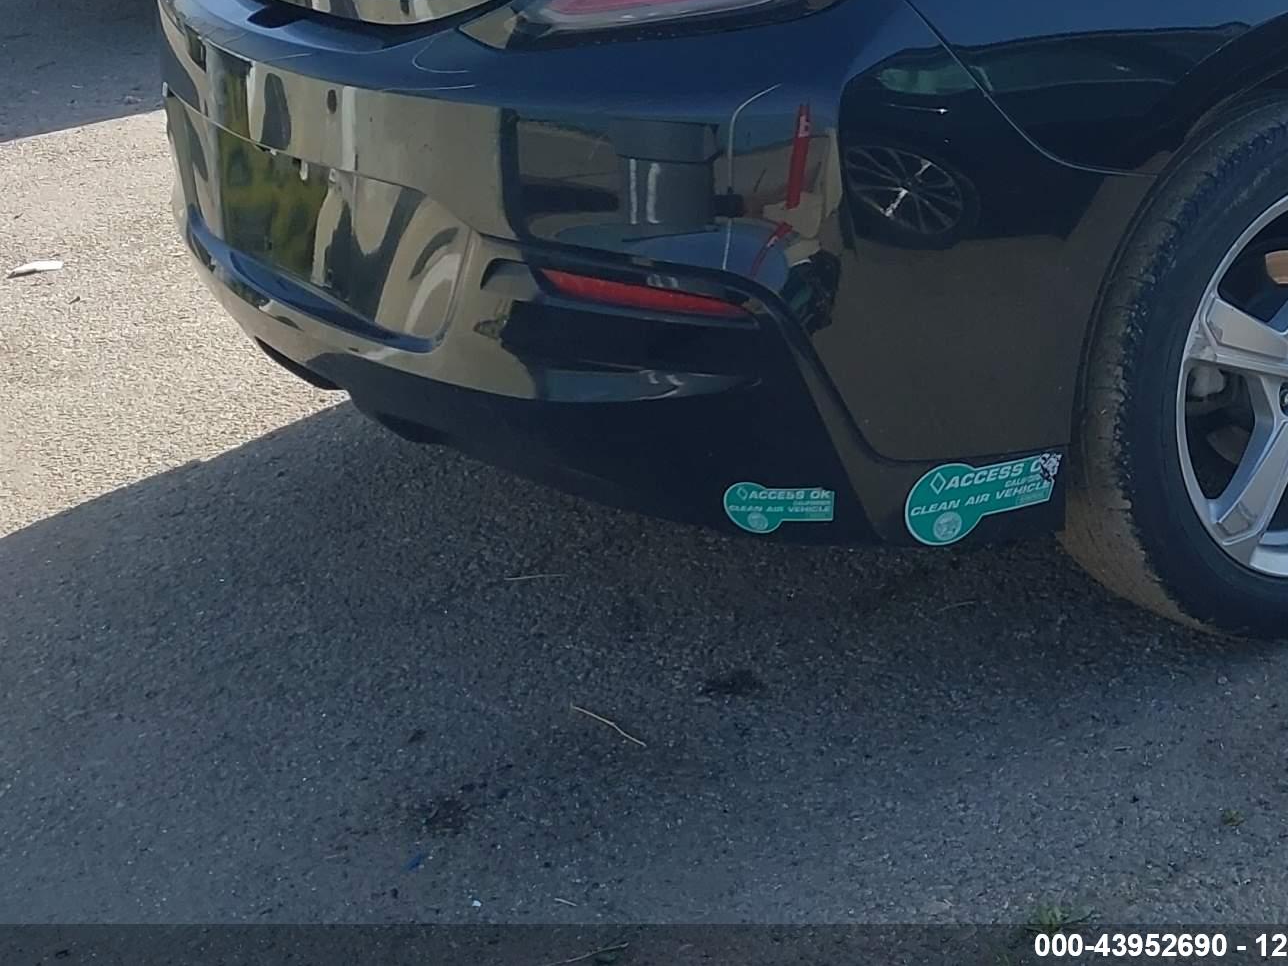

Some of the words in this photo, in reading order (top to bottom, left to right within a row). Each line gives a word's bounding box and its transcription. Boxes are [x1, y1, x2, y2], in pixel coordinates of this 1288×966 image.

[945, 463, 1025, 491] ACCESS
[810, 490, 831, 500] OK
[788, 505, 830, 513] VEHICLE
[911, 500, 960, 516] CLEAN
[965, 494, 990, 506] AIR
